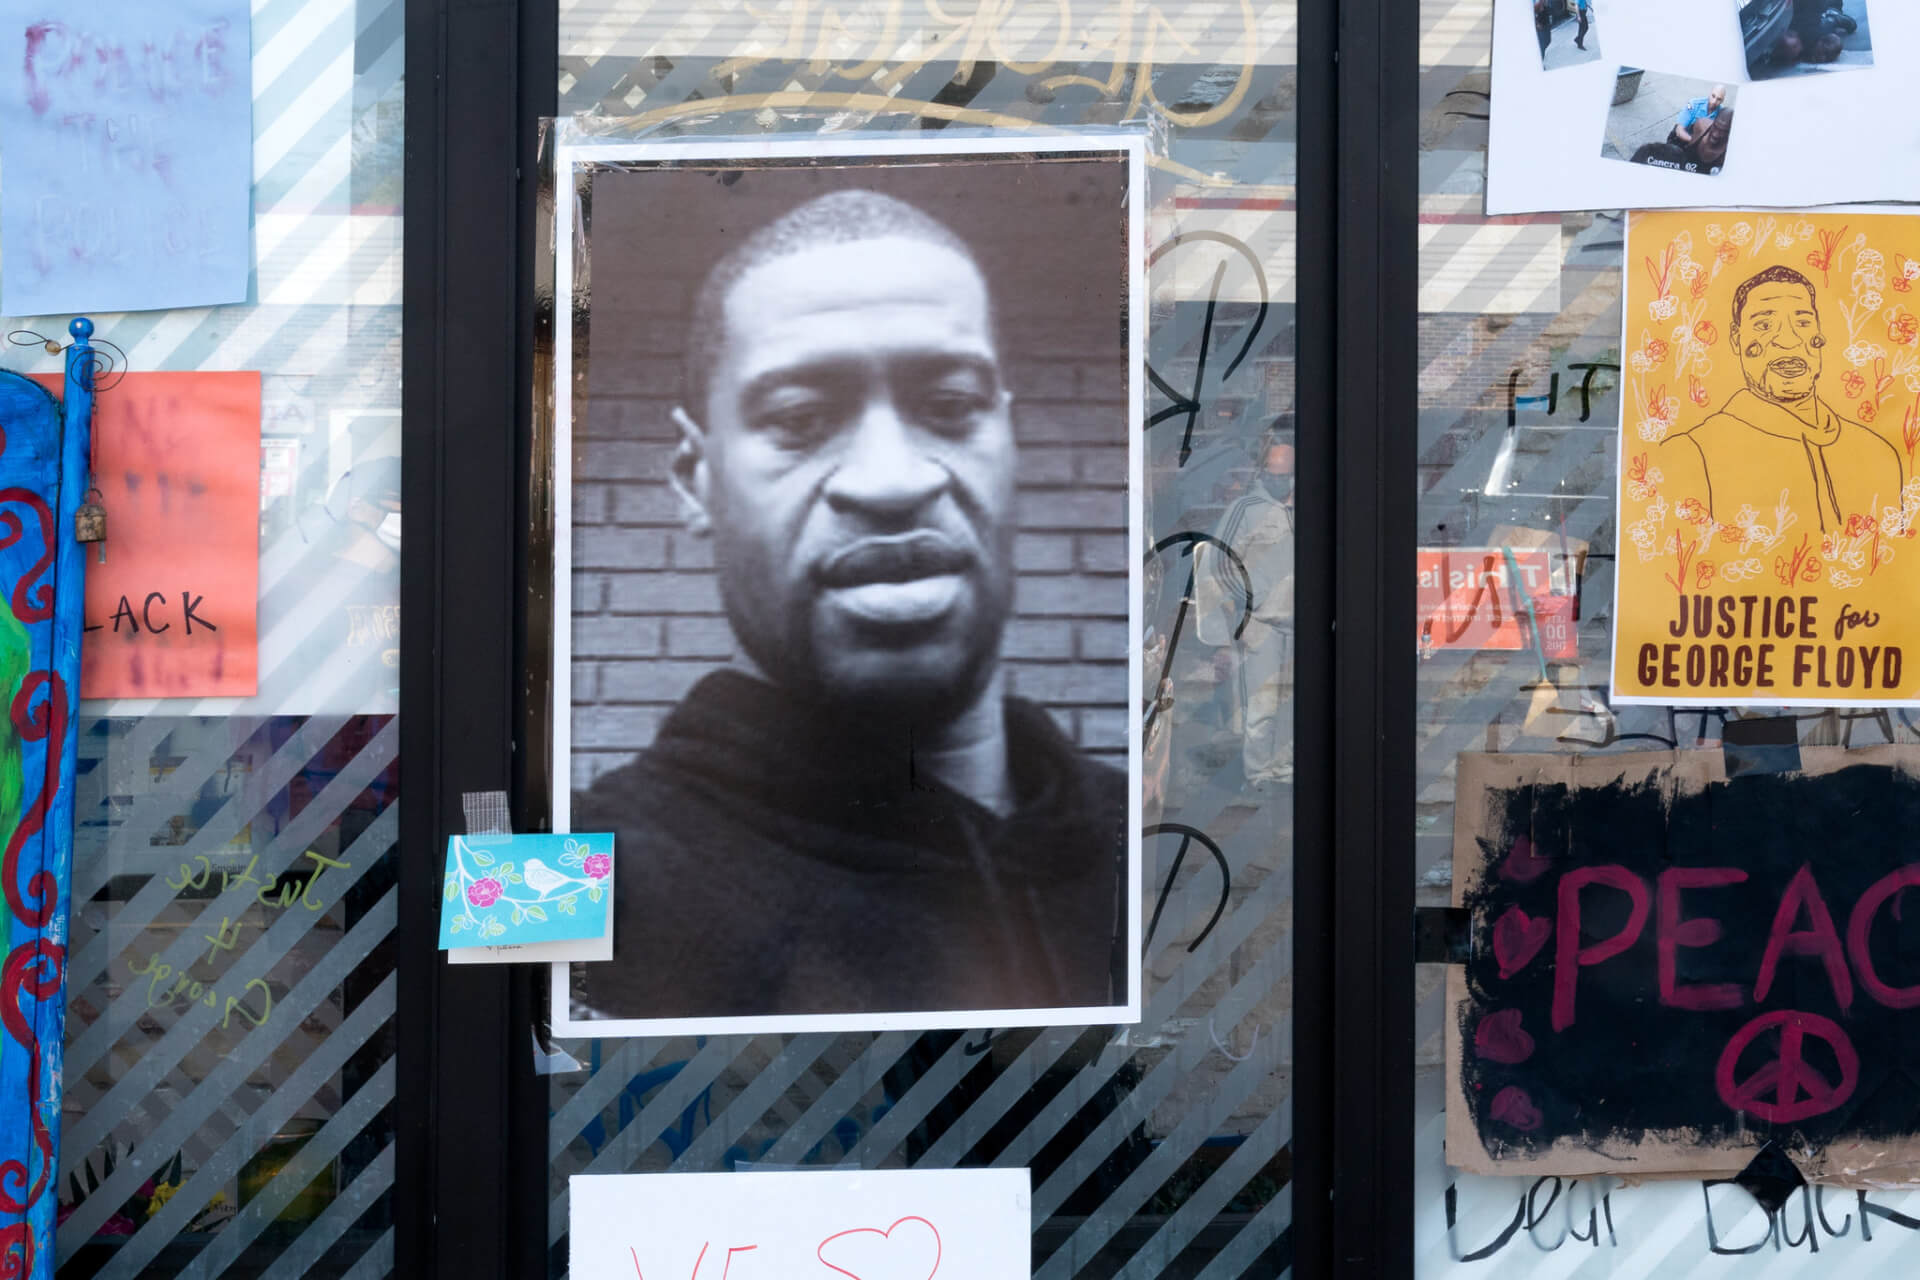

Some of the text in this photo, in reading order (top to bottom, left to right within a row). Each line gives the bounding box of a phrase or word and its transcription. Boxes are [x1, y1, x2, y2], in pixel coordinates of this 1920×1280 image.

[1685, 162, 1697, 173] 02
[1669, 594, 1880, 640] JUSTICE for
[1637, 643, 1902, 689] GEORGE FLOYD
